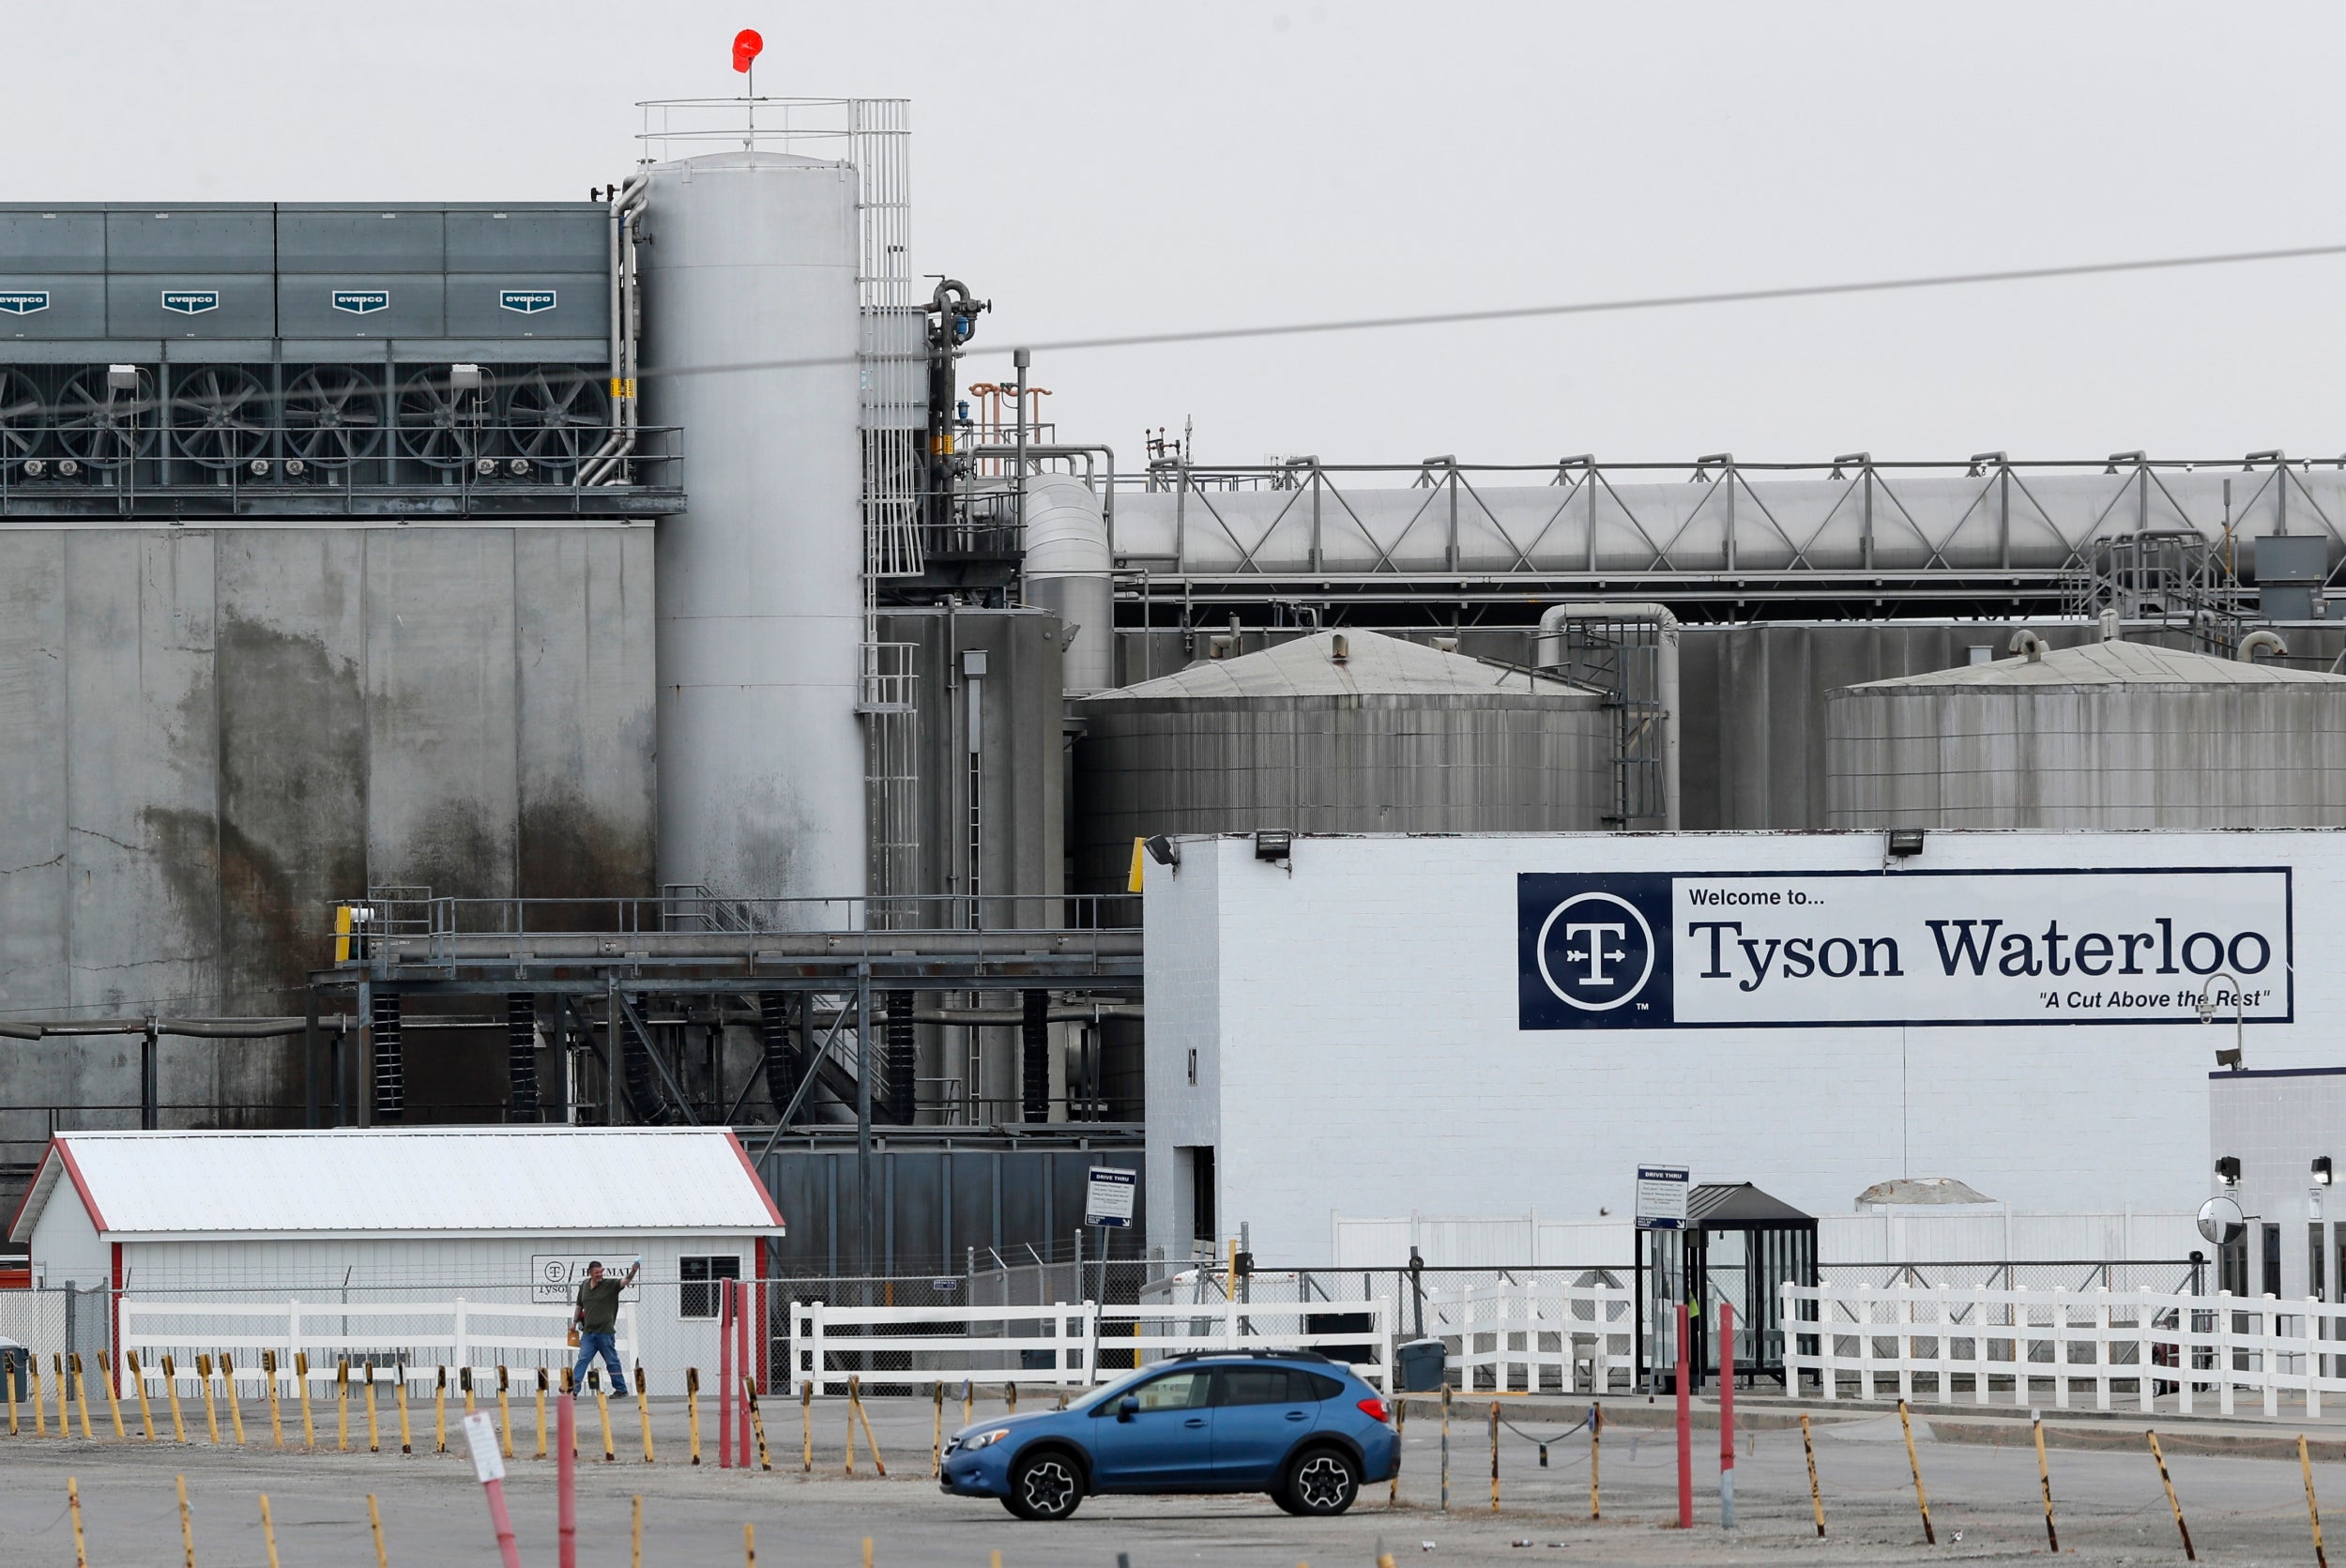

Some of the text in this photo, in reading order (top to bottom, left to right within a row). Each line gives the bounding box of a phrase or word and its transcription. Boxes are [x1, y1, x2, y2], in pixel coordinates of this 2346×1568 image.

[1688, 889, 1825, 906] Welcome to...
[1688, 918, 2271, 993] Tyson Waterloo
[2066, 991, 2103, 1009] Cut
[2108, 990, 2171, 1008] Above
